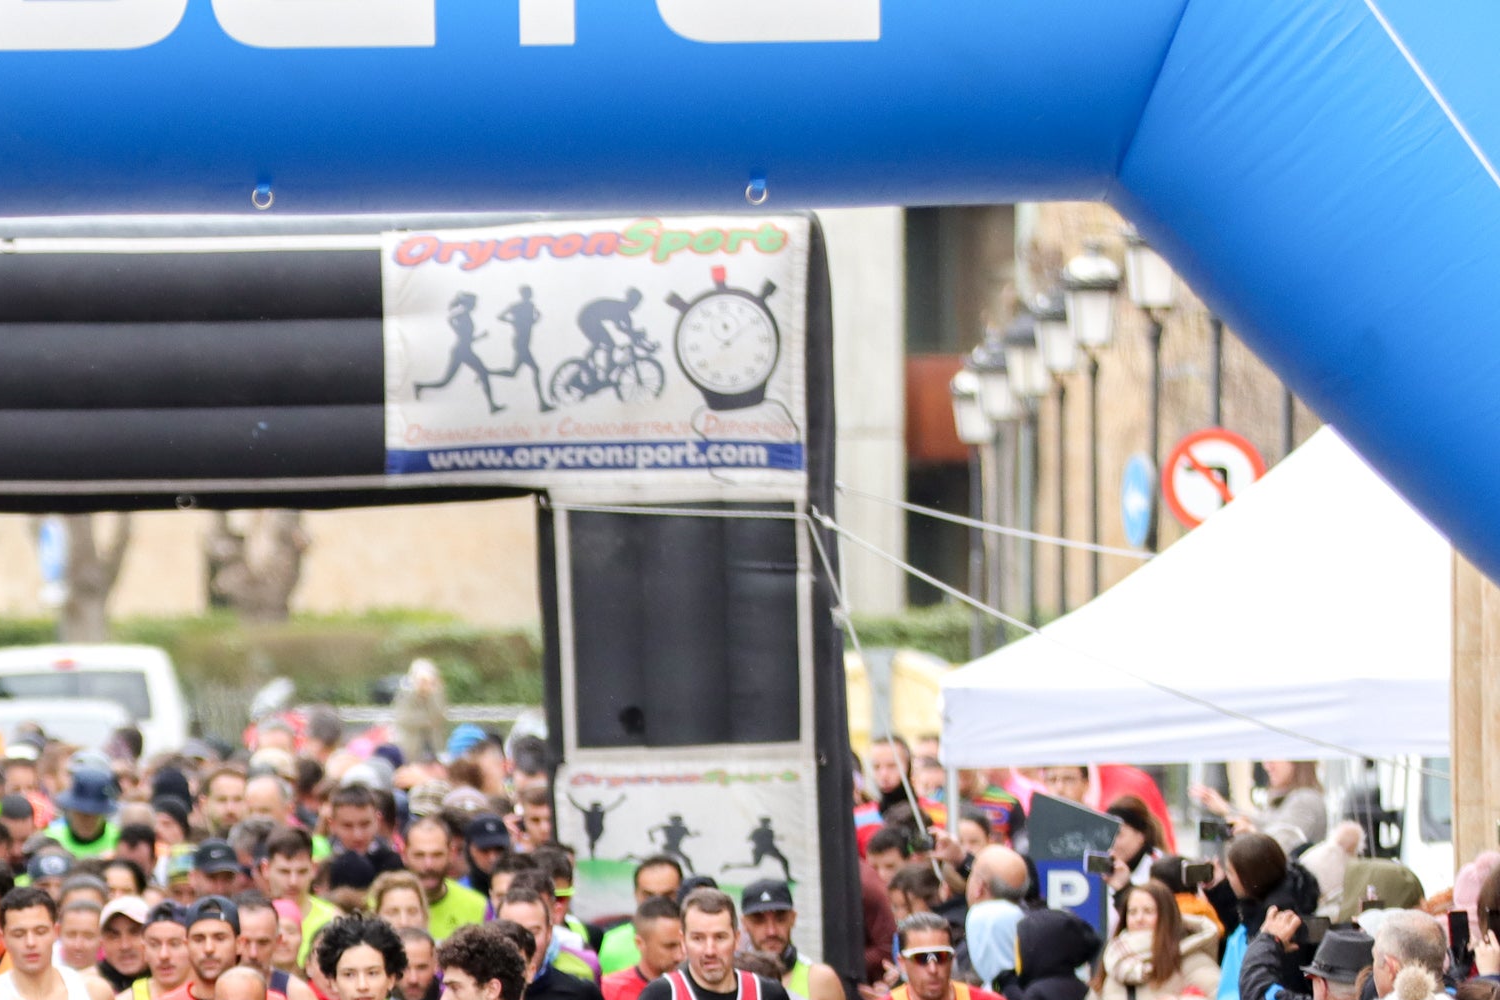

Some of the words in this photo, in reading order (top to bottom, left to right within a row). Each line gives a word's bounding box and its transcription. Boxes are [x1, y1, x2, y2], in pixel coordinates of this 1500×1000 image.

[393, 218, 789, 270] OrycronSport
[427, 440, 769, 470] www.orycronsport.com
[1046, 869, 1090, 910] P
